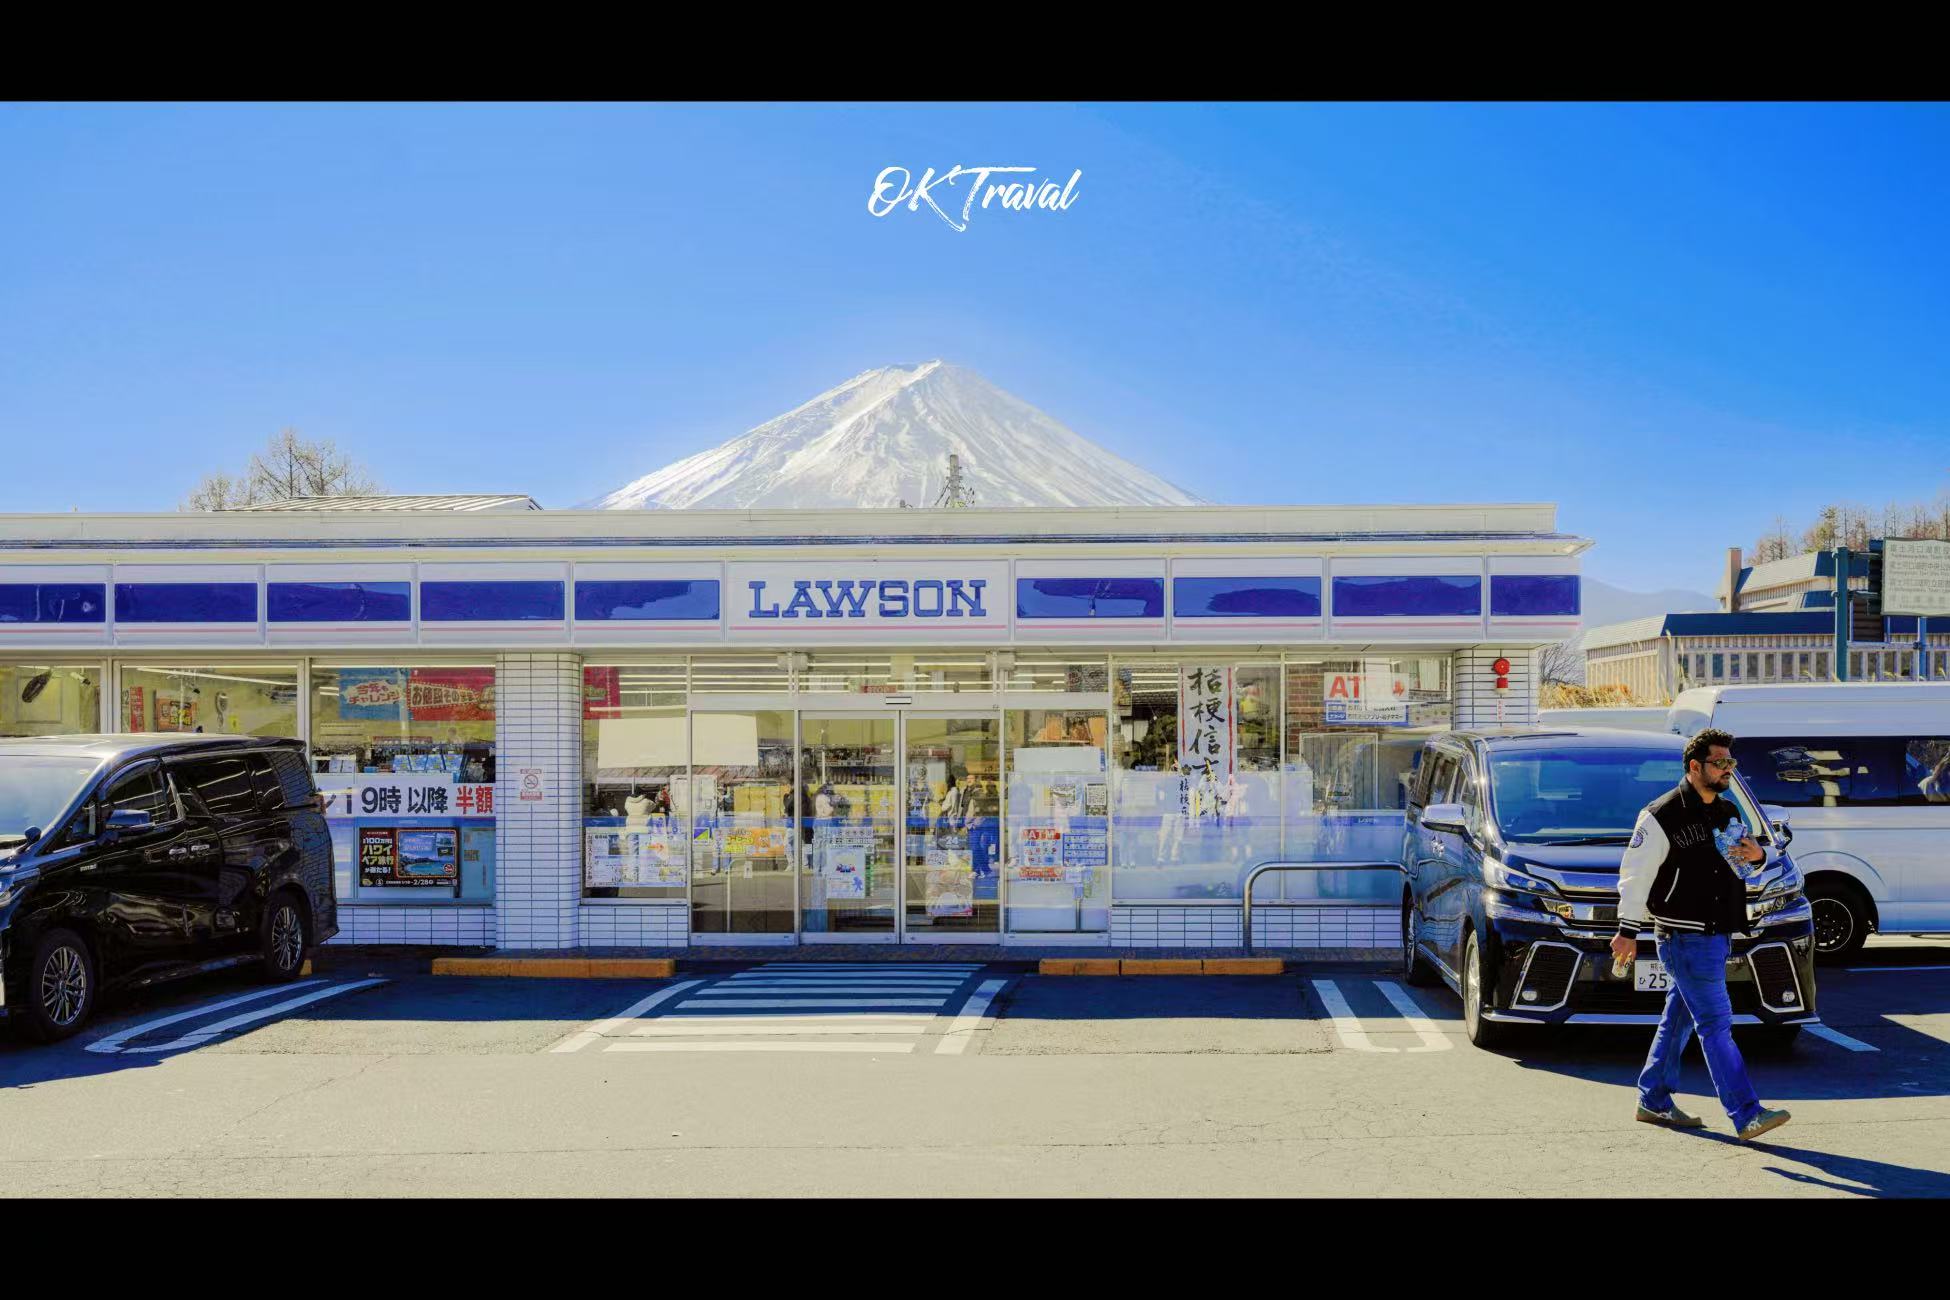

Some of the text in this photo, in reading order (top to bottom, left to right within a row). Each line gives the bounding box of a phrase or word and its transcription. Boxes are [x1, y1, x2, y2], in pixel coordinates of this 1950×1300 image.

[748, 580, 987, 618] LAWSON
[1329, 675, 1374, 699] AT
[362, 844, 393, 855] ハワイ
